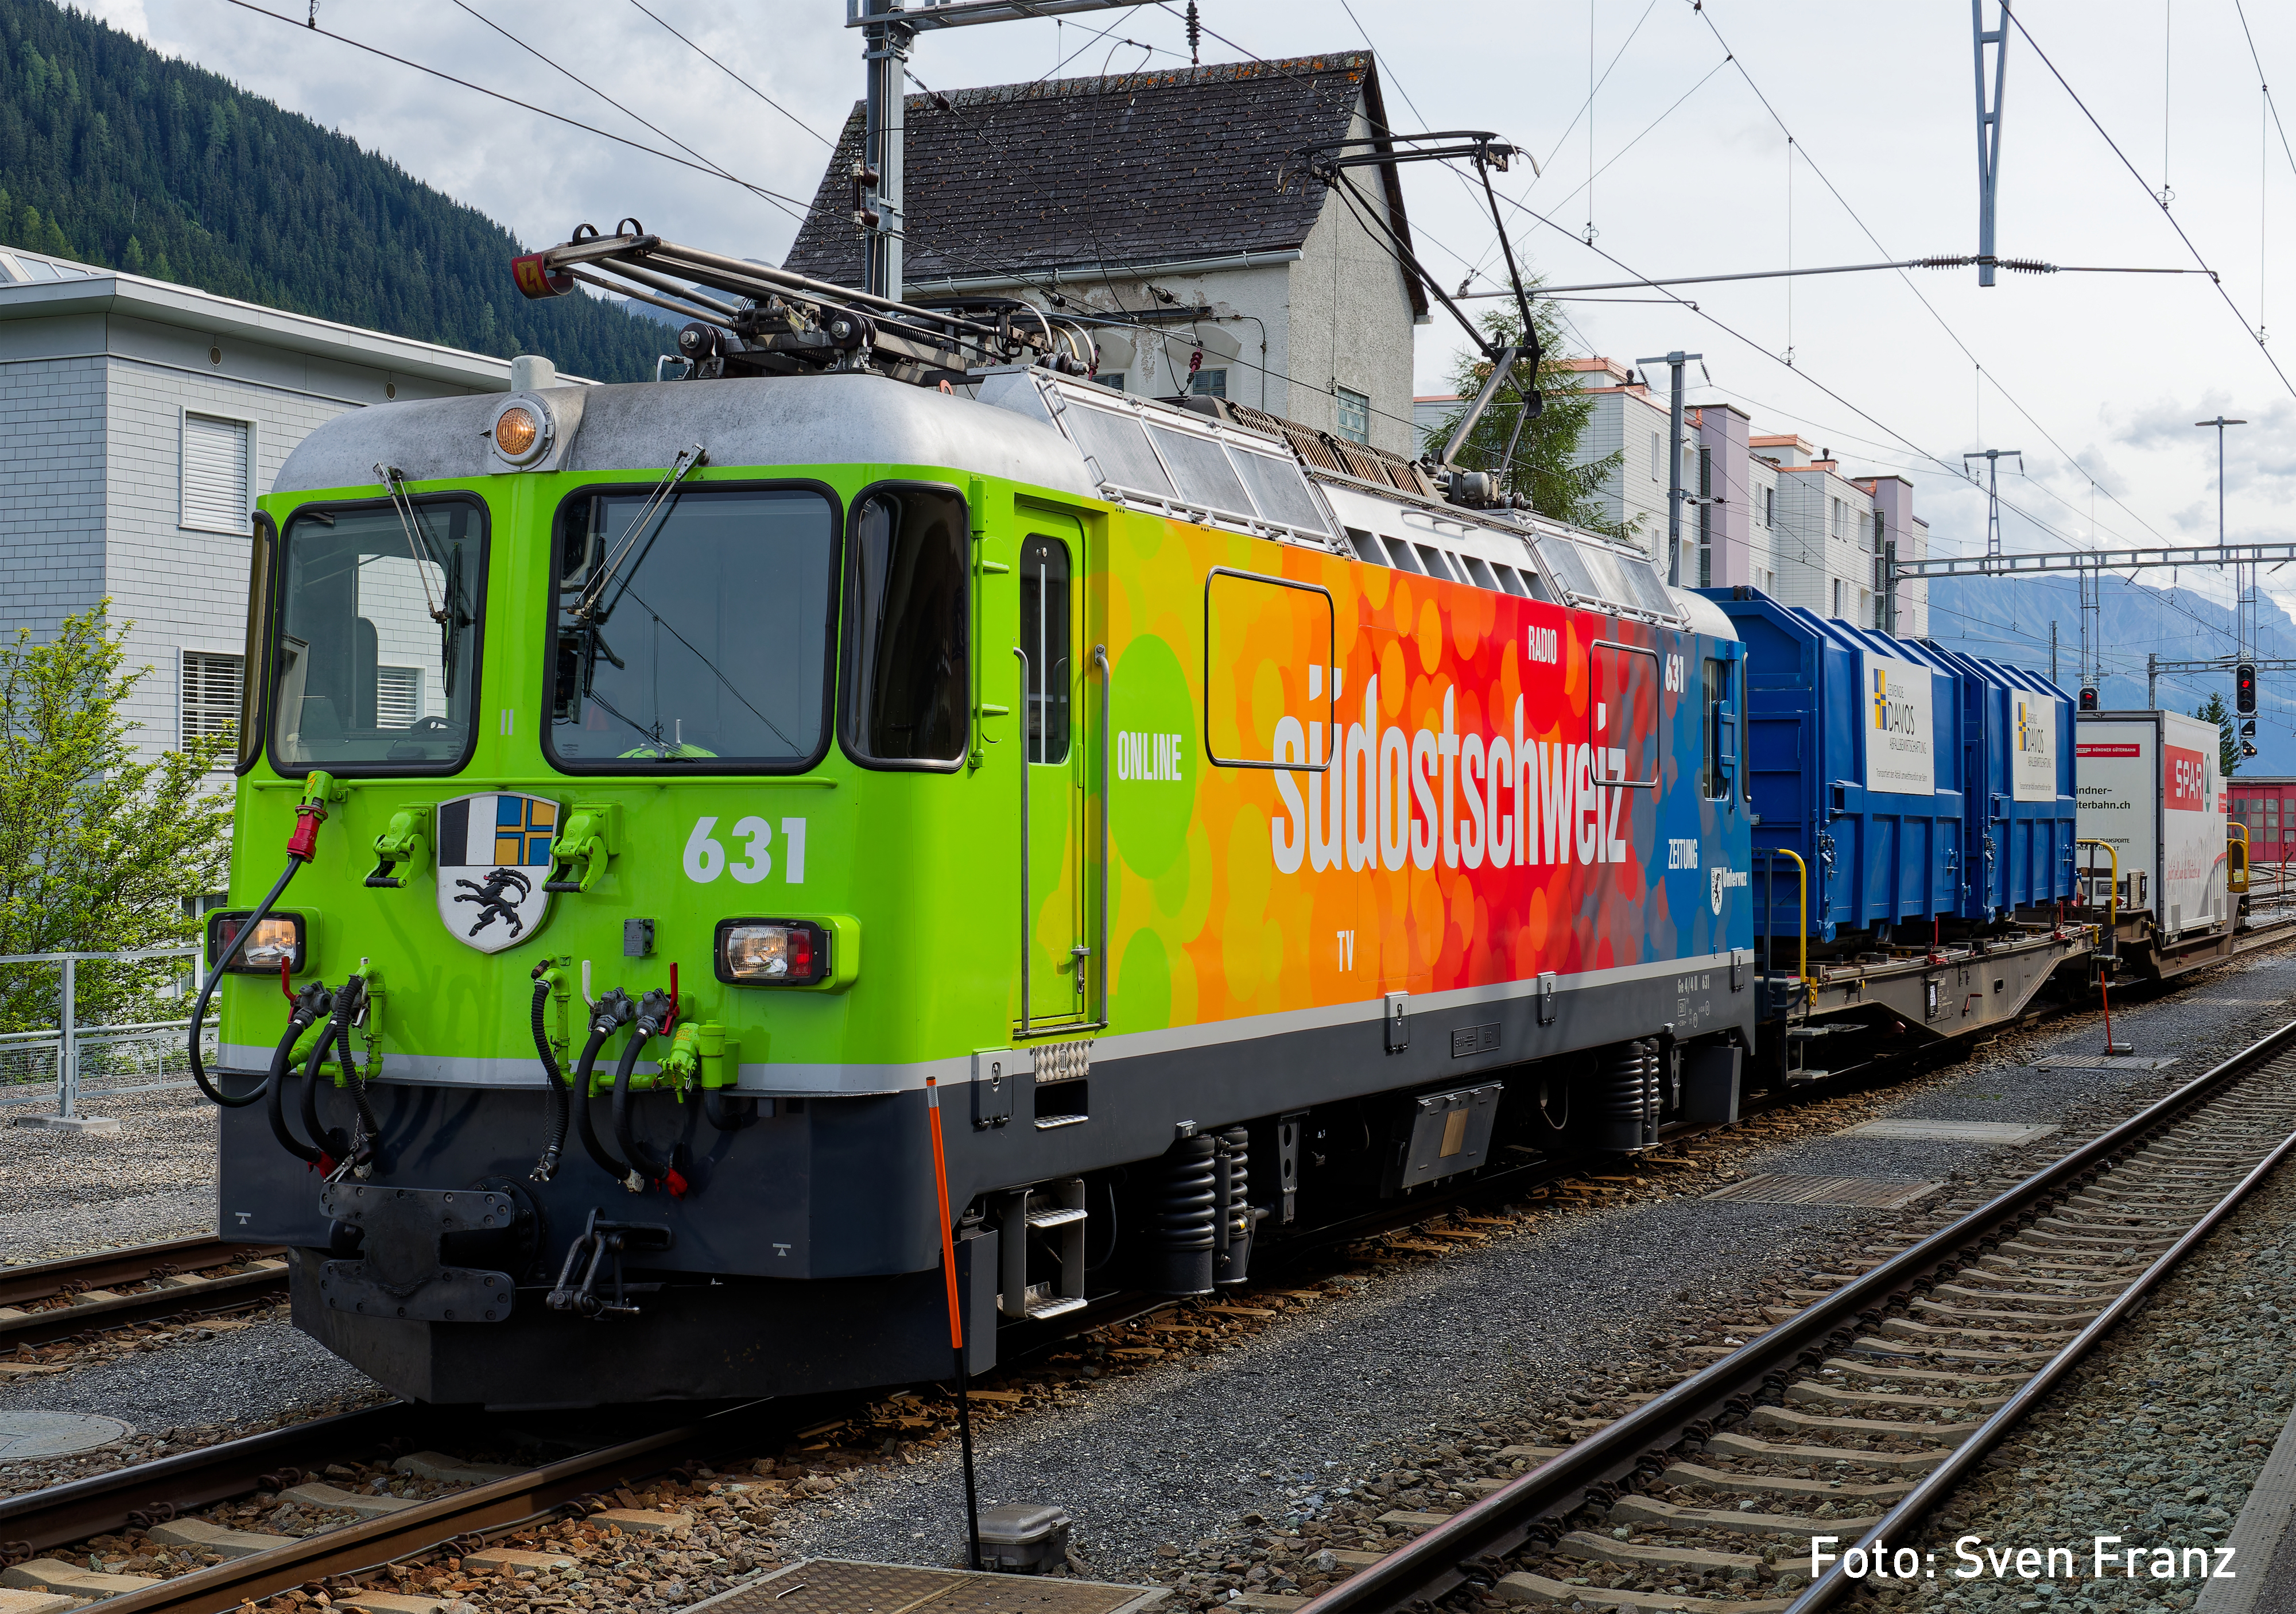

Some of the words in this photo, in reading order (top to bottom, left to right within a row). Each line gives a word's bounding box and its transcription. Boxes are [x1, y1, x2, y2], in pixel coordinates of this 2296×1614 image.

[1528, 625, 1557, 665] RADIO
[1666, 653, 1684, 693] 631
[1888, 701, 1915, 736] DAVOS
[1118, 731, 1182, 781] ONLINE
[2027, 727, 2044, 753] DAVOS
[1272, 664, 1626, 874] südostschweiz
[2175, 759, 2202, 800] SPAR
[682, 816, 806, 884] 631
[1668, 838, 1698, 869] ZEITUNG
[1723, 867, 1747, 888] Untervaz
[1337, 930, 1354, 972] TV
[1677, 978, 1684, 994] Ge
[1684, 976, 1693, 994] 4/4
